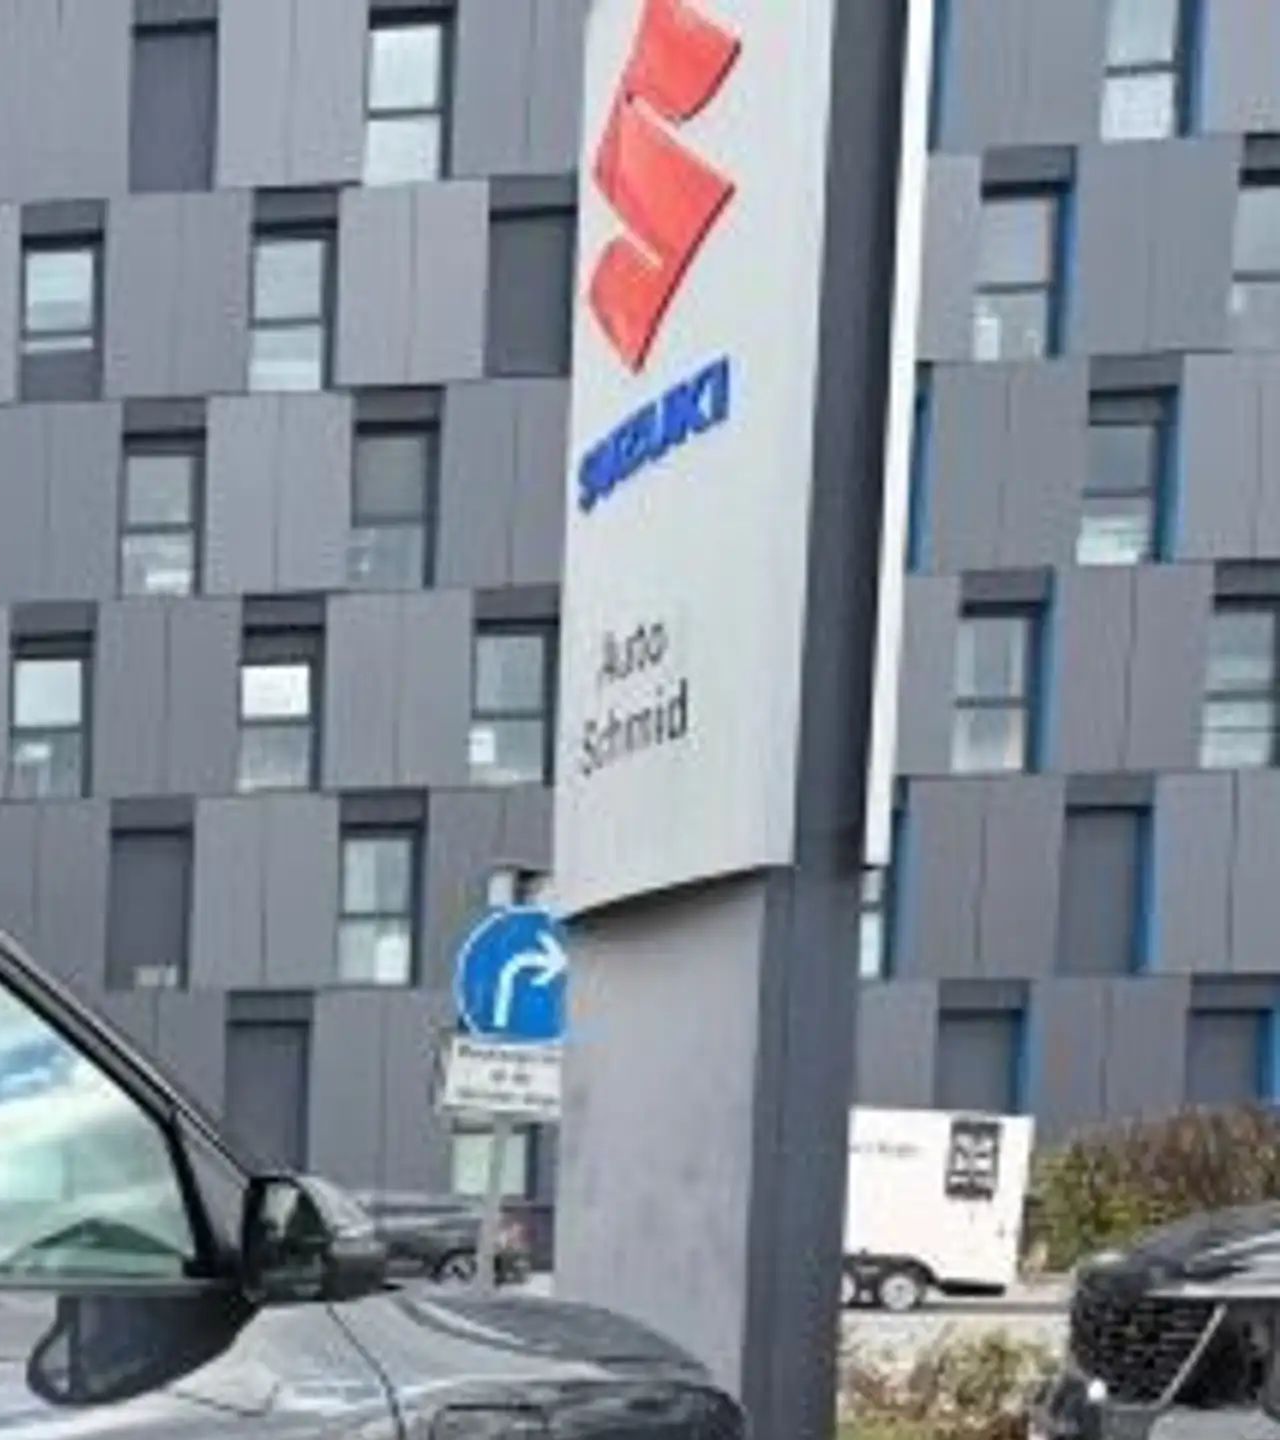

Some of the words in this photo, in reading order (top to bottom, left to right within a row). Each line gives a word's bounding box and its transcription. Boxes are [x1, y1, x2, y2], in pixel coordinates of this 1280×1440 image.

[578, 355, 731, 514] SUZUKI
[597, 620, 669, 684] Auto
[578, 676, 690, 778] Schmid
